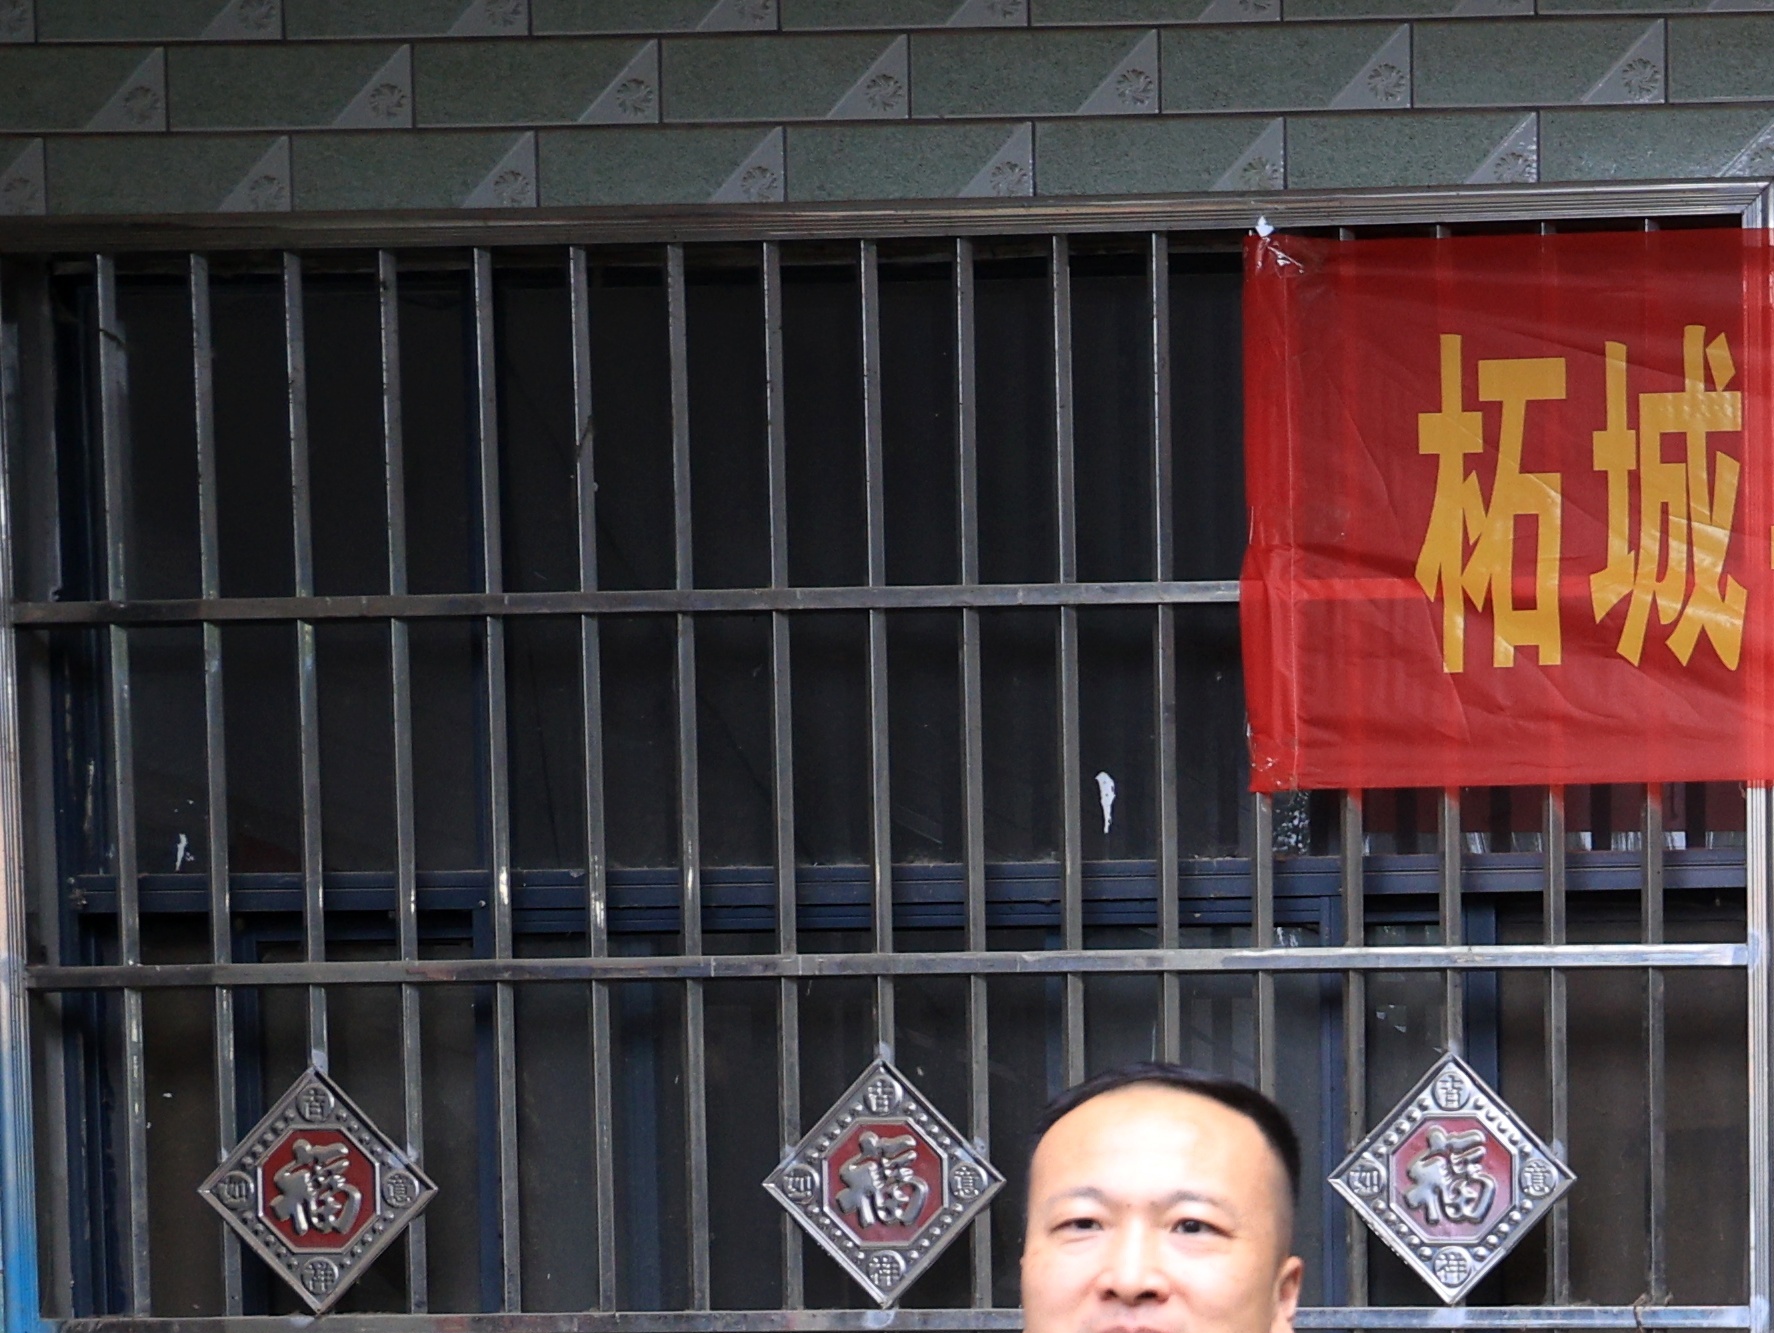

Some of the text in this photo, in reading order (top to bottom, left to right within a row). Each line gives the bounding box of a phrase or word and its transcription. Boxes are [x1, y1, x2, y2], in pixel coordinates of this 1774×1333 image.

[269, 1138, 363, 1237] 福
[835, 1130, 929, 1229] 福
[1402, 1124, 1497, 1226] 福
